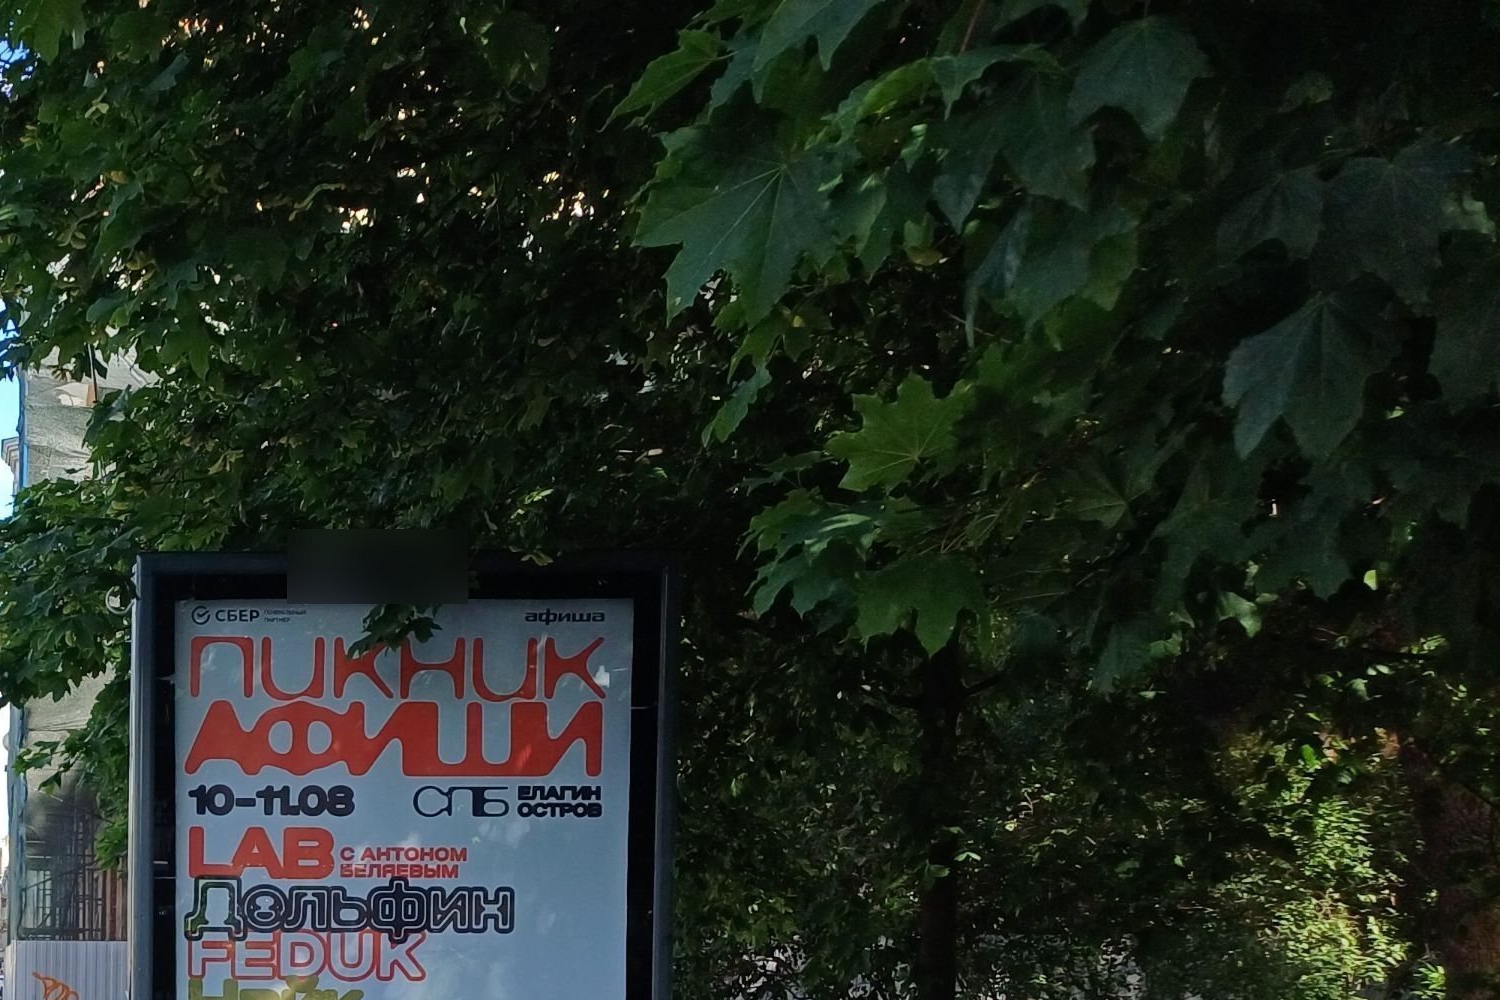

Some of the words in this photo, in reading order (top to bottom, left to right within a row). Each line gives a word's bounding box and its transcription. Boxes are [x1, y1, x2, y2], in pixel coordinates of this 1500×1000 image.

[215, 609, 260, 622] СБЕР
[525, 609, 605, 625] афиша
[185, 700, 604, 776] АФИШИ
[413, 785, 509, 818] СПБ
[517, 786, 602, 801] ЕЛАГИН
[517, 802, 603, 818] ОСТРОВ
[188, 826, 335, 880] LAB
[339, 846, 355, 862] С
[360, 847, 468, 863] АНТОНОМ
[339, 863, 460, 879] БЕЛЯЕВЫМ
[187, 930, 426, 982] FEDUK
